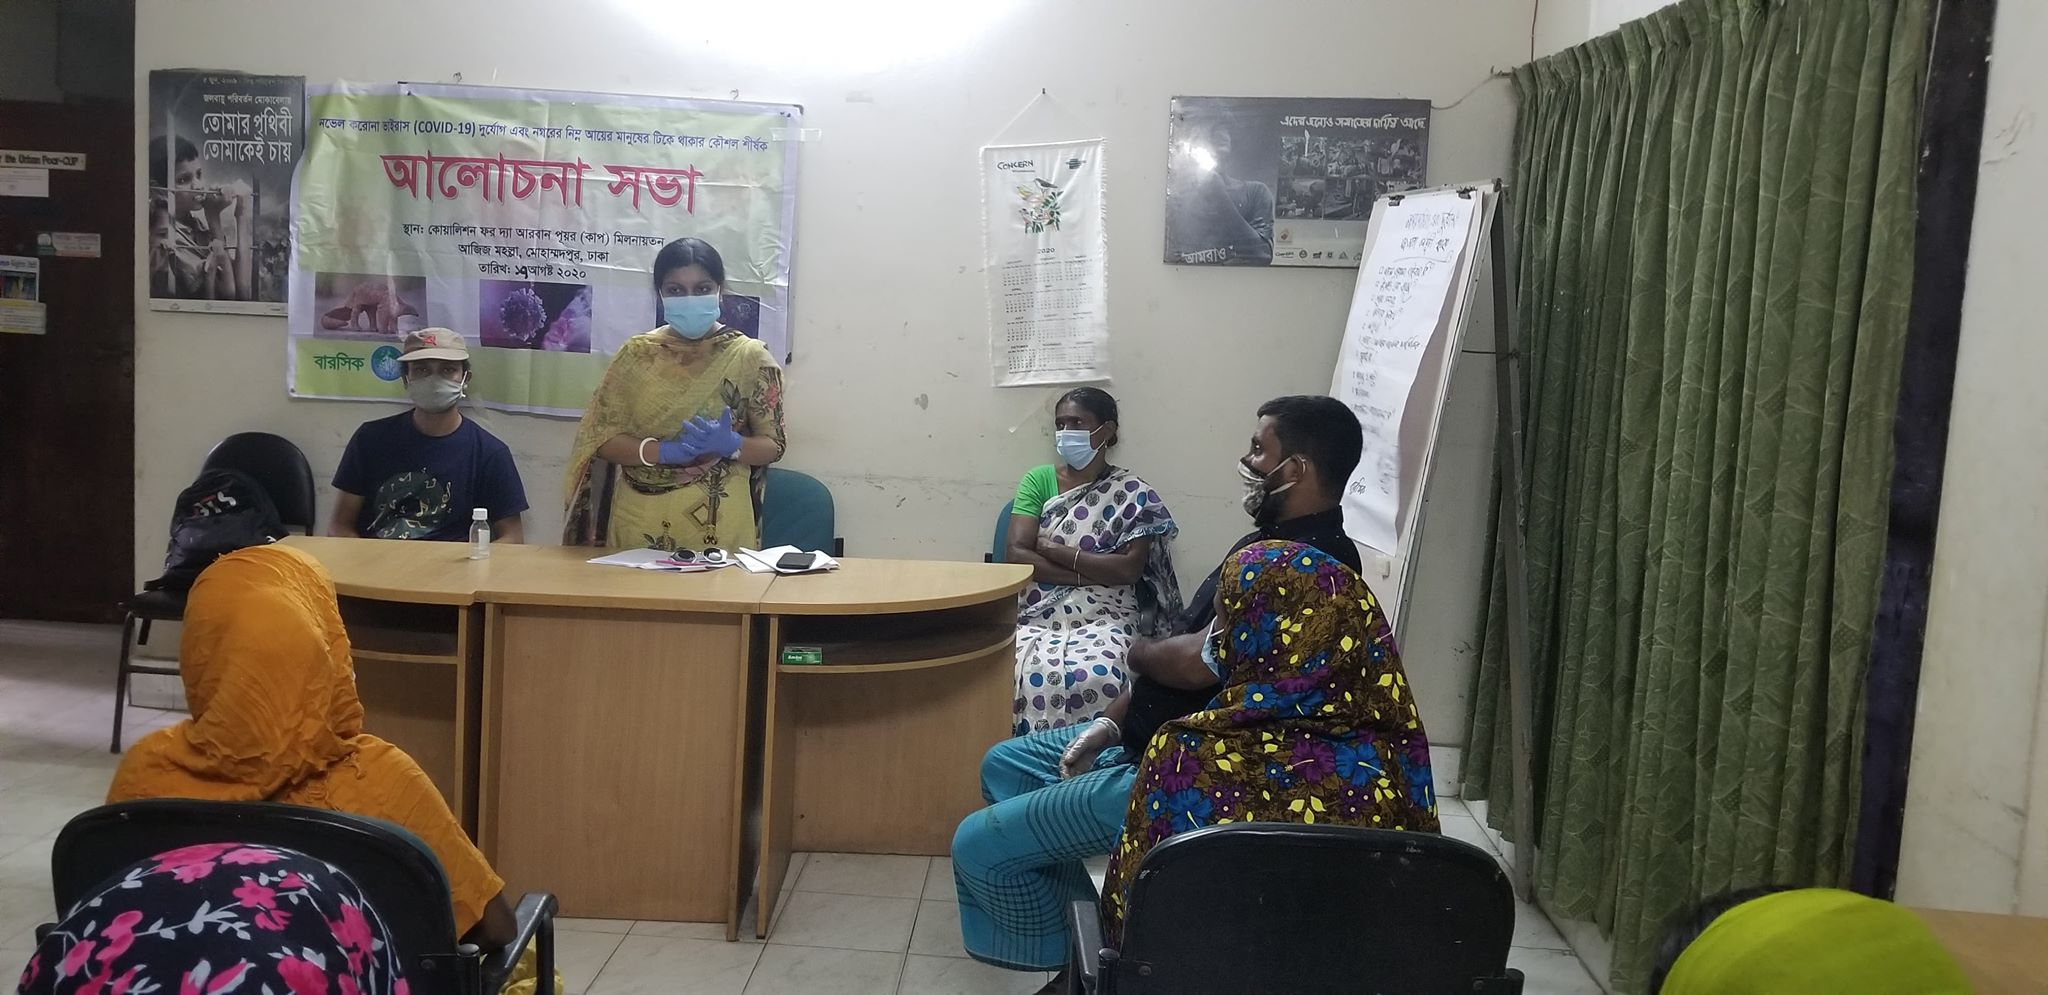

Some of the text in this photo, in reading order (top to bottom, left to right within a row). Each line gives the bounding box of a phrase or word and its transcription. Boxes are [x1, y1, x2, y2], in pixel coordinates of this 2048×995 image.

[202, 107, 293, 138] তোমার পৃথিবী
[319, 118, 345, 130] নভেল
[349, 119, 380, 133] করোনা
[383, 118, 410, 133] ভাইরাস
[414, 119, 476, 138] (COVID-19)
[479, 121, 507, 137] দুর্যোগ
[510, 126, 530, 138] এবং
[532, 126, 562, 139] নগরের
[585, 130, 613, 142] আয়ের
[616, 131, 650, 146] মানুষের
[653, 130, 675, 145] টিকে
[678, 134, 705, 148] থাকার
[709, 135, 739, 150] কৌশল
[742, 136, 769, 151] শীর্ষক
[203, 134, 293, 165] তোমাকেই চায়
[997, 160, 1034, 170] CONCERN
[379, 149, 705, 216] আলোচনা সভা
[428, 222, 477, 237] কোয়ালিশন
[480, 226, 496, 237] ফর
[499, 227, 513, 239] দ্যা
[515, 228, 552, 240] আরবান
[580, 231, 610, 246] (কাপ)
[614, 231, 665, 247] মিলনায়তন
[458, 241, 609, 264] আজিজ মহল্লা, মোহাম্মদপুর, ঢাকা
[1181, 247, 1226, 264] আমরাও
[478, 260, 511, 274] তারিখ:
[557, 267, 587, 280] ২০২০
[313, 352, 365, 371] বারসিক
